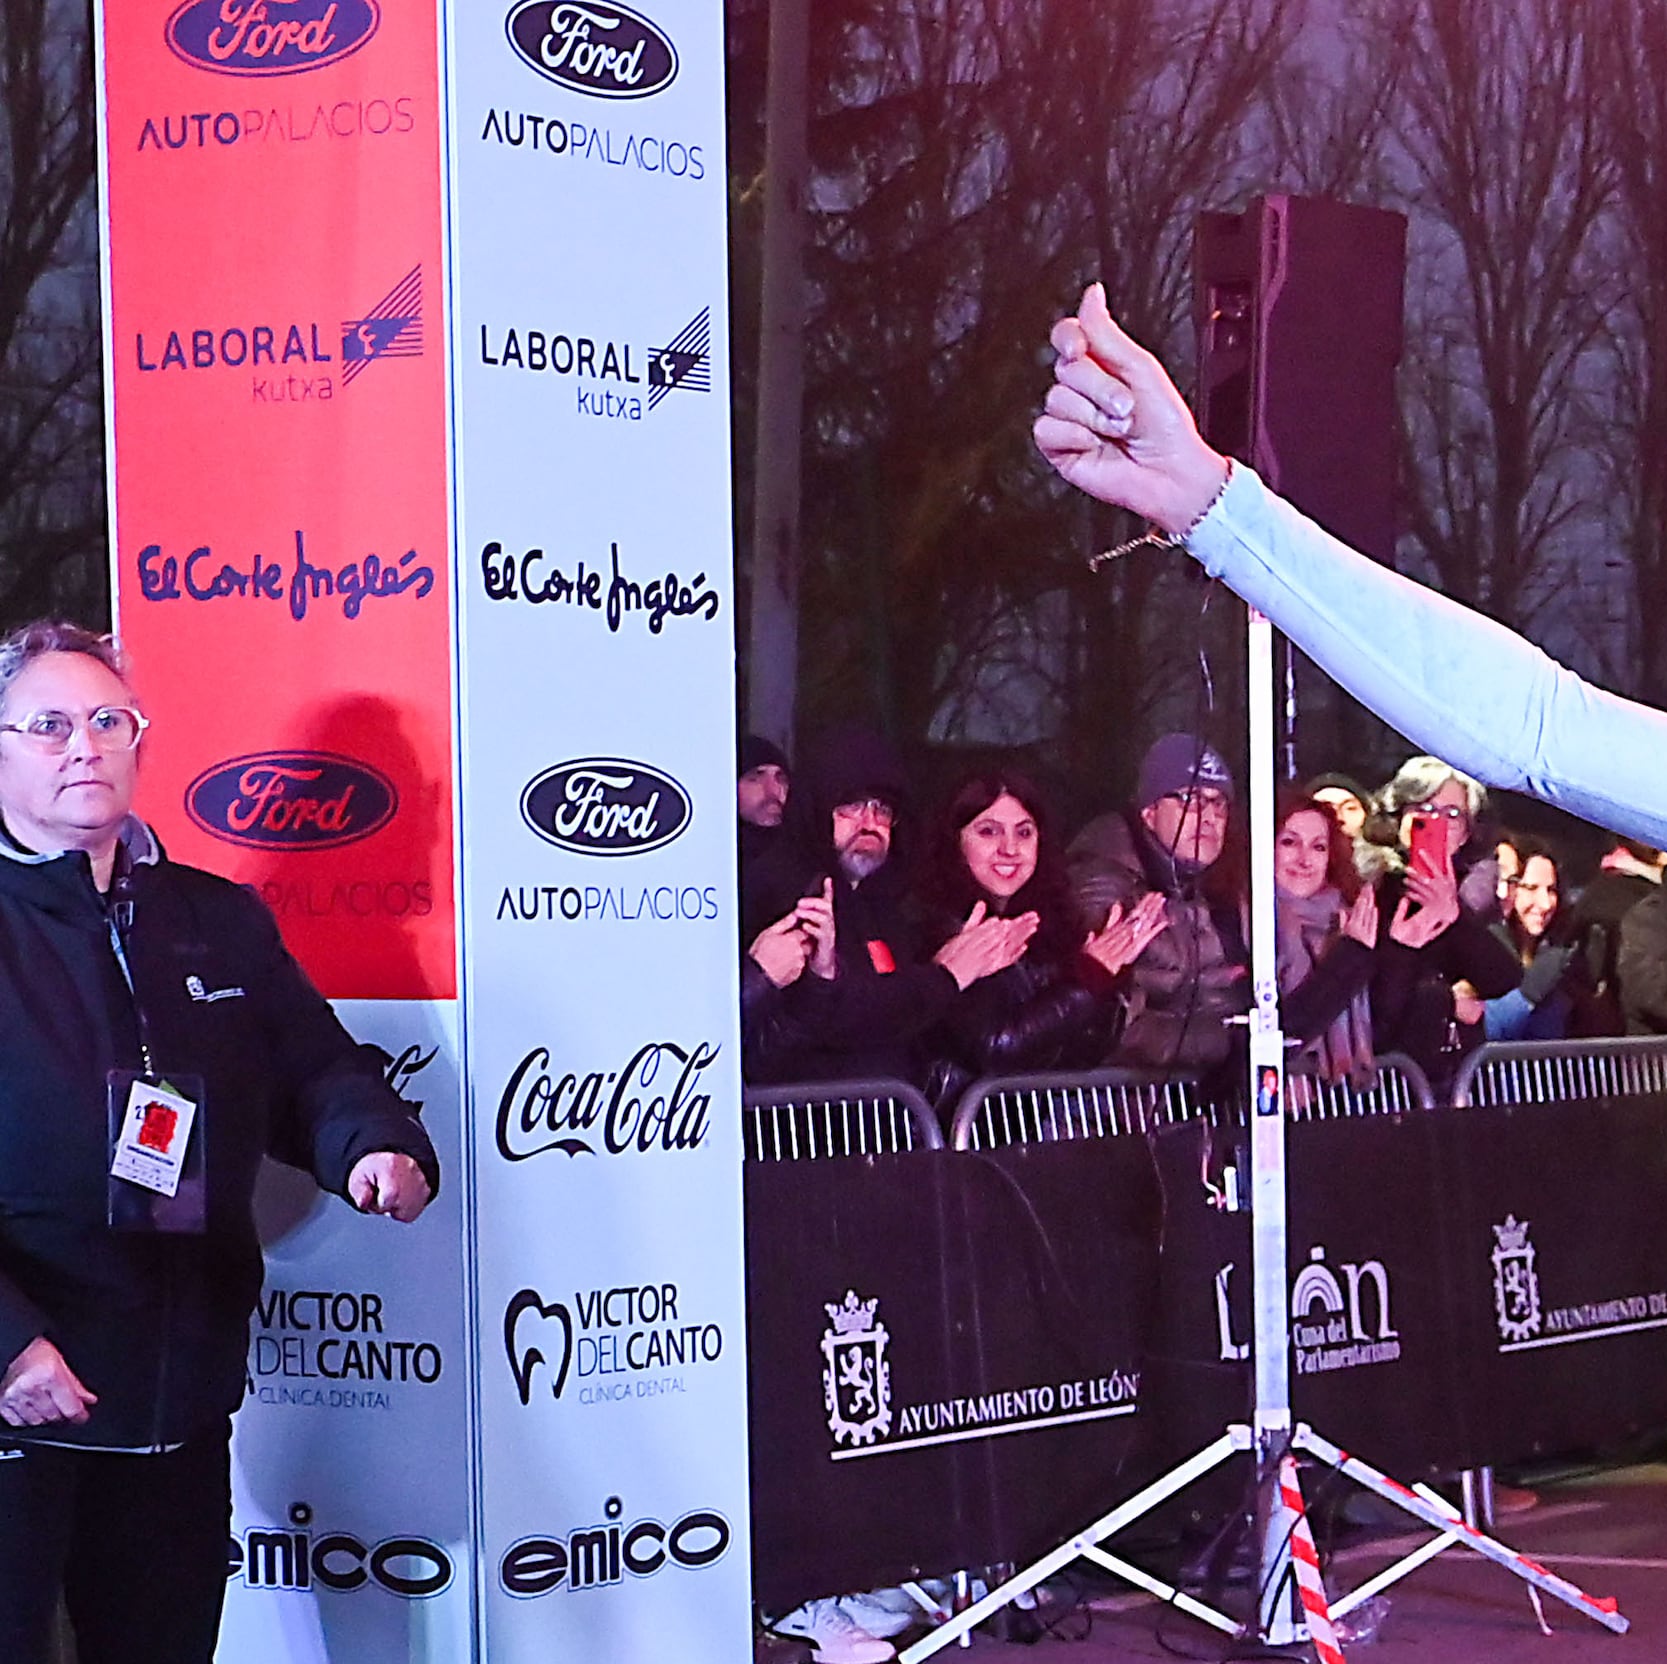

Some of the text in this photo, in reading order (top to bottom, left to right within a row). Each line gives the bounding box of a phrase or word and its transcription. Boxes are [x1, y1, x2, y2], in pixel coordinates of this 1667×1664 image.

[208, 0, 338, 59] Ford
[541, 4, 646, 85] Ford
[137, 98, 415, 151] AUTOPALACIOS
[482, 108, 705, 180] AUTOPALACIOS
[135, 323, 332, 372] LABORAL
[480, 324, 642, 385] LABORAL
[251, 369, 334, 402] kutxa
[576, 385, 643, 421] kutxa
[137, 530, 434, 621] El Corte Inglés
[481, 540, 719, 635] El Corte Inglés
[226, 765, 354, 834] Ford
[553, 769, 660, 841] Ford
[258, 880, 433, 917] PALACIOS
[496, 886, 719, 921] AUTOPALACIOS
[496, 1041, 721, 1161] Coca-Cola
[257, 1289, 383, 1333] VICTOR
[575, 1283, 679, 1330] VICTOR
[256, 1336, 442, 1384] DELCANTO
[577, 1323, 722, 1378] DELCANTO
[636, 1376, 688, 1399] DENTAL
[900, 1369, 1138, 1434] AYUNTAMIENTO DE LEÓN
[229, 1502, 452, 1597] mico
[501, 1496, 730, 1594] emico
